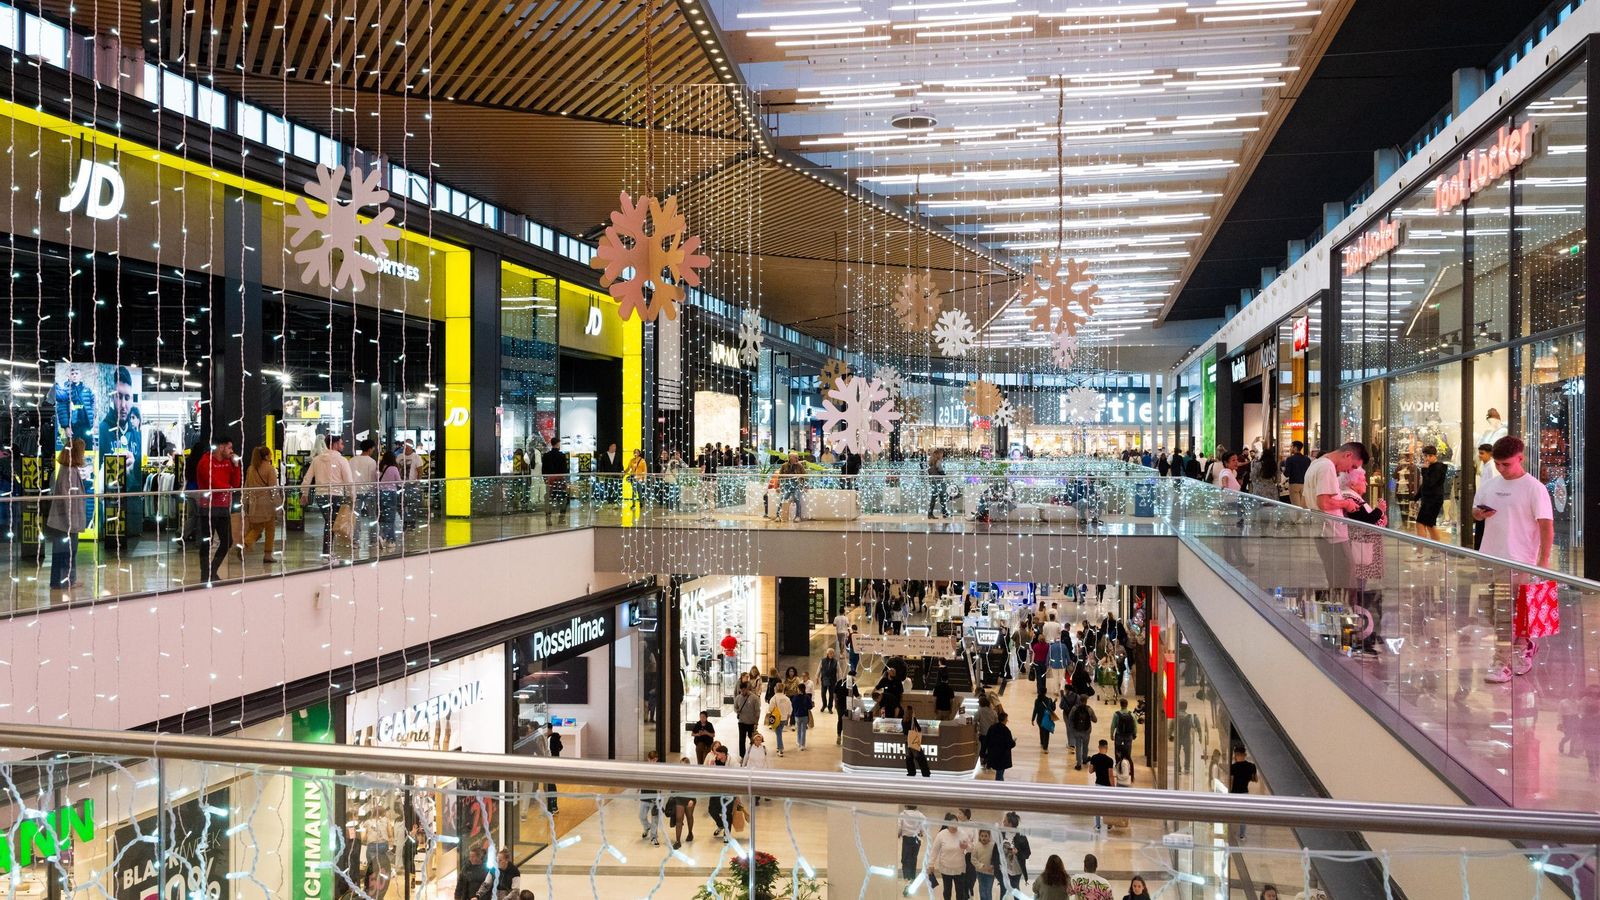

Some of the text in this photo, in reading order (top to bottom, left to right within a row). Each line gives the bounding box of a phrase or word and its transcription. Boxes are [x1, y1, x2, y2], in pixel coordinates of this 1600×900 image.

[59, 158, 125, 220] JD
[584, 305, 602, 336] JD
[444, 407, 470, 427] JD
[533, 616, 605, 662] Rossellimac
[874, 741, 938, 757] SINHMO
